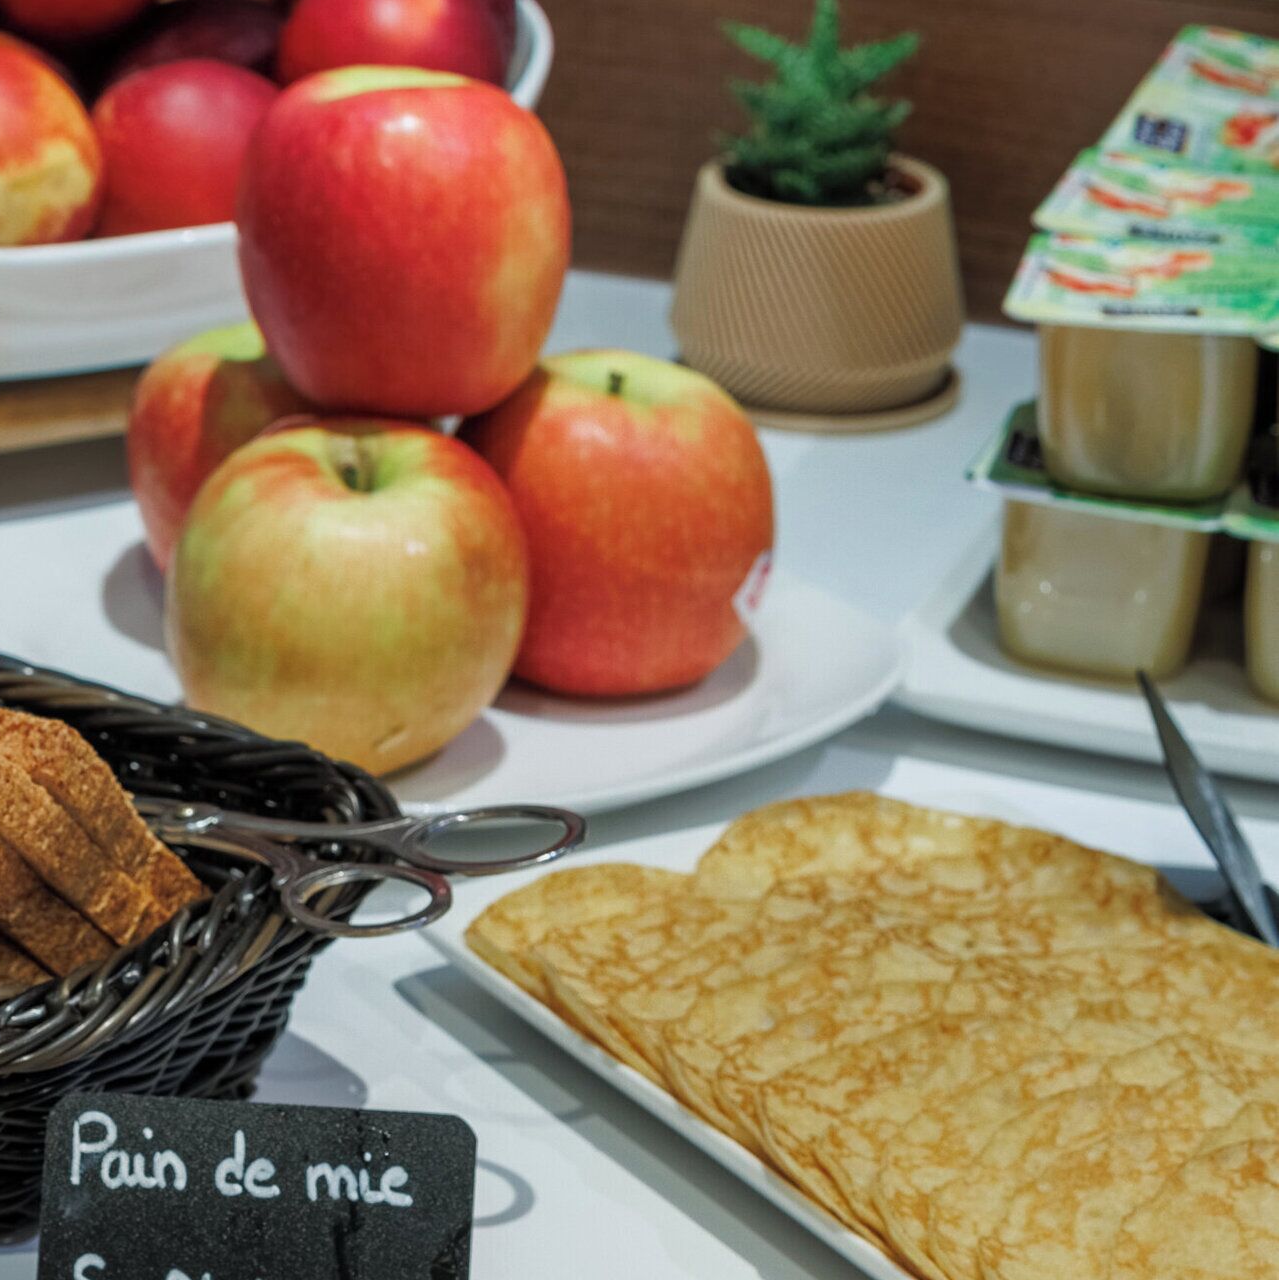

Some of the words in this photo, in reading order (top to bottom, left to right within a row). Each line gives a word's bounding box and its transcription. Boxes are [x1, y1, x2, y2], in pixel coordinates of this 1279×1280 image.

[70, 1111, 186, 1190] Pain
[215, 1129, 280, 1198] de
[306, 1152, 413, 1206] mie
